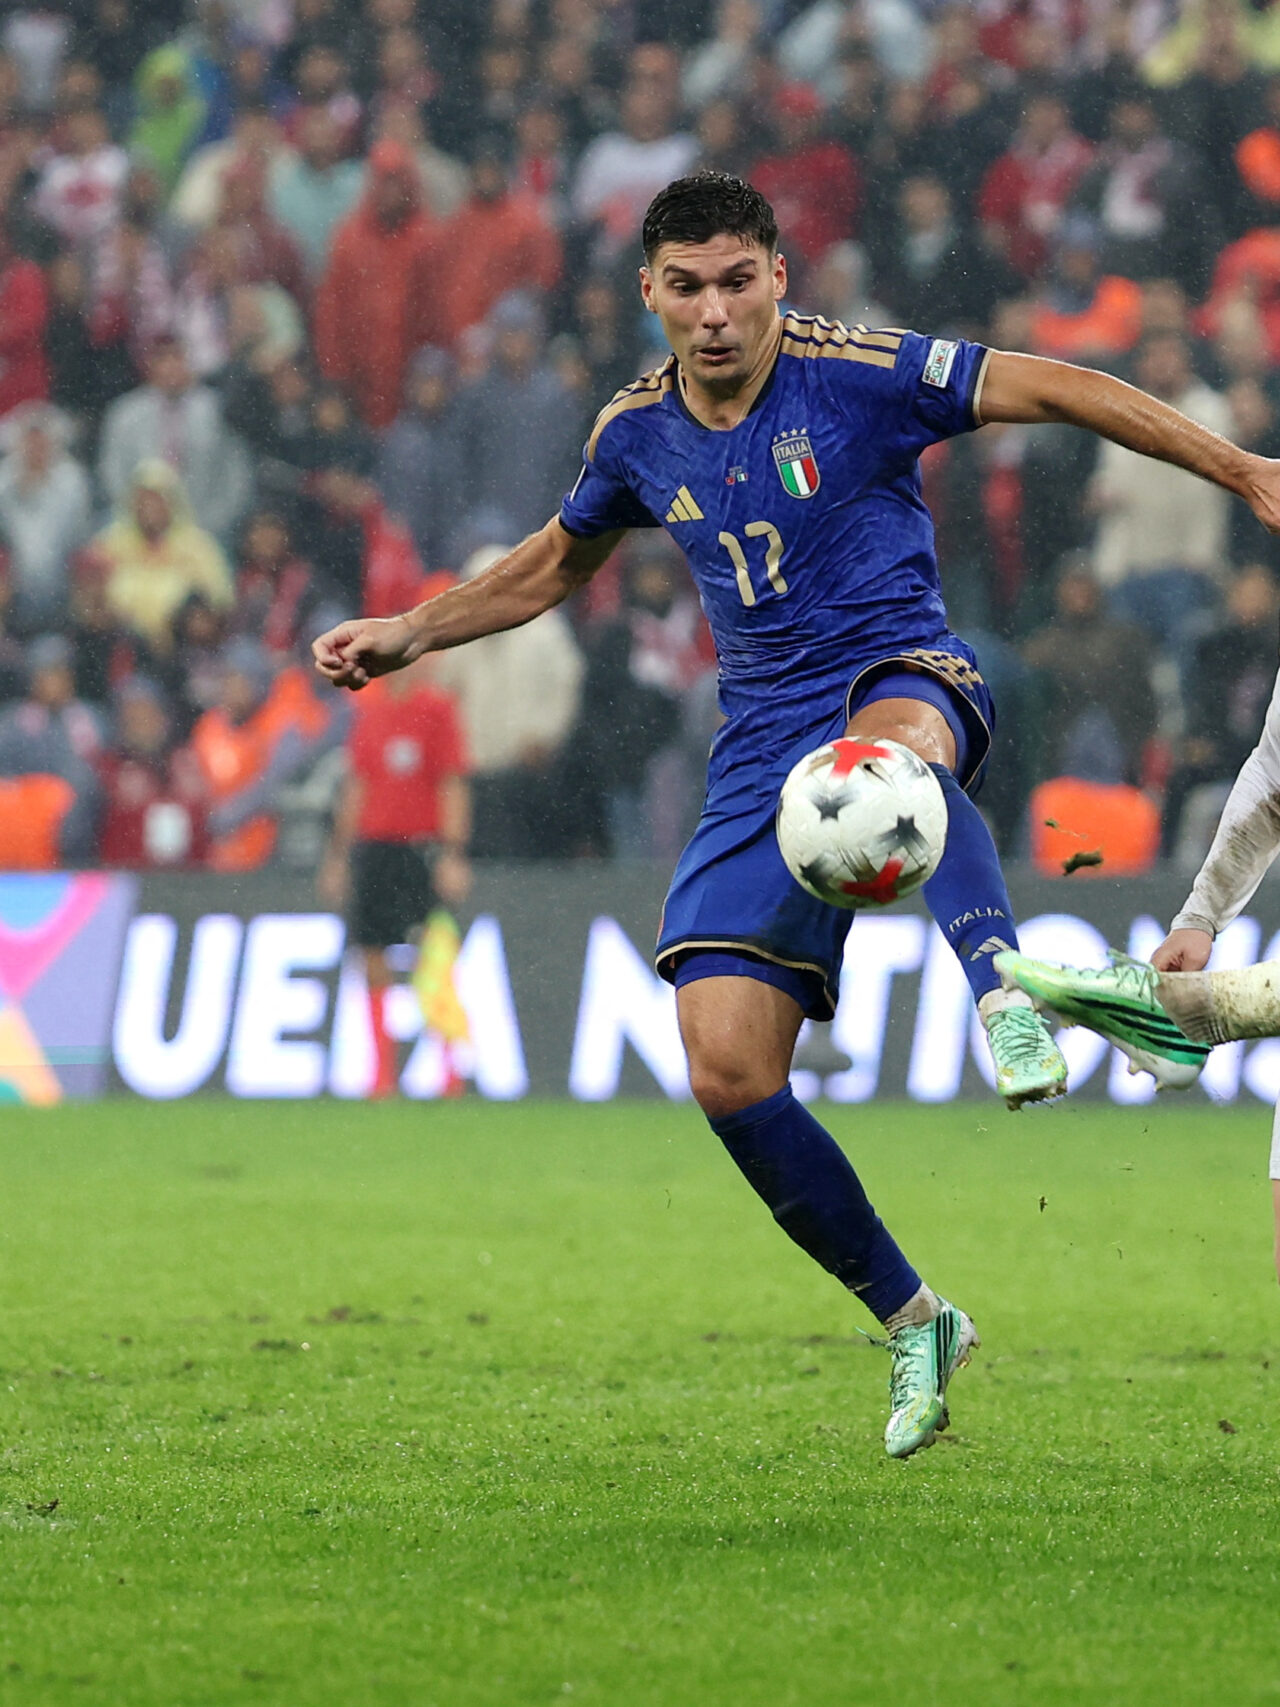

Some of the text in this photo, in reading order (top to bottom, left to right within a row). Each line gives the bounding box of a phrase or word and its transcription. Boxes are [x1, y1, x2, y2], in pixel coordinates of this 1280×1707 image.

[776, 441, 809, 460] ITALIA
[718, 520, 788, 607] 17
[949, 907, 1006, 933] ITALIA
[112, 911, 530, 1101] UEFA
